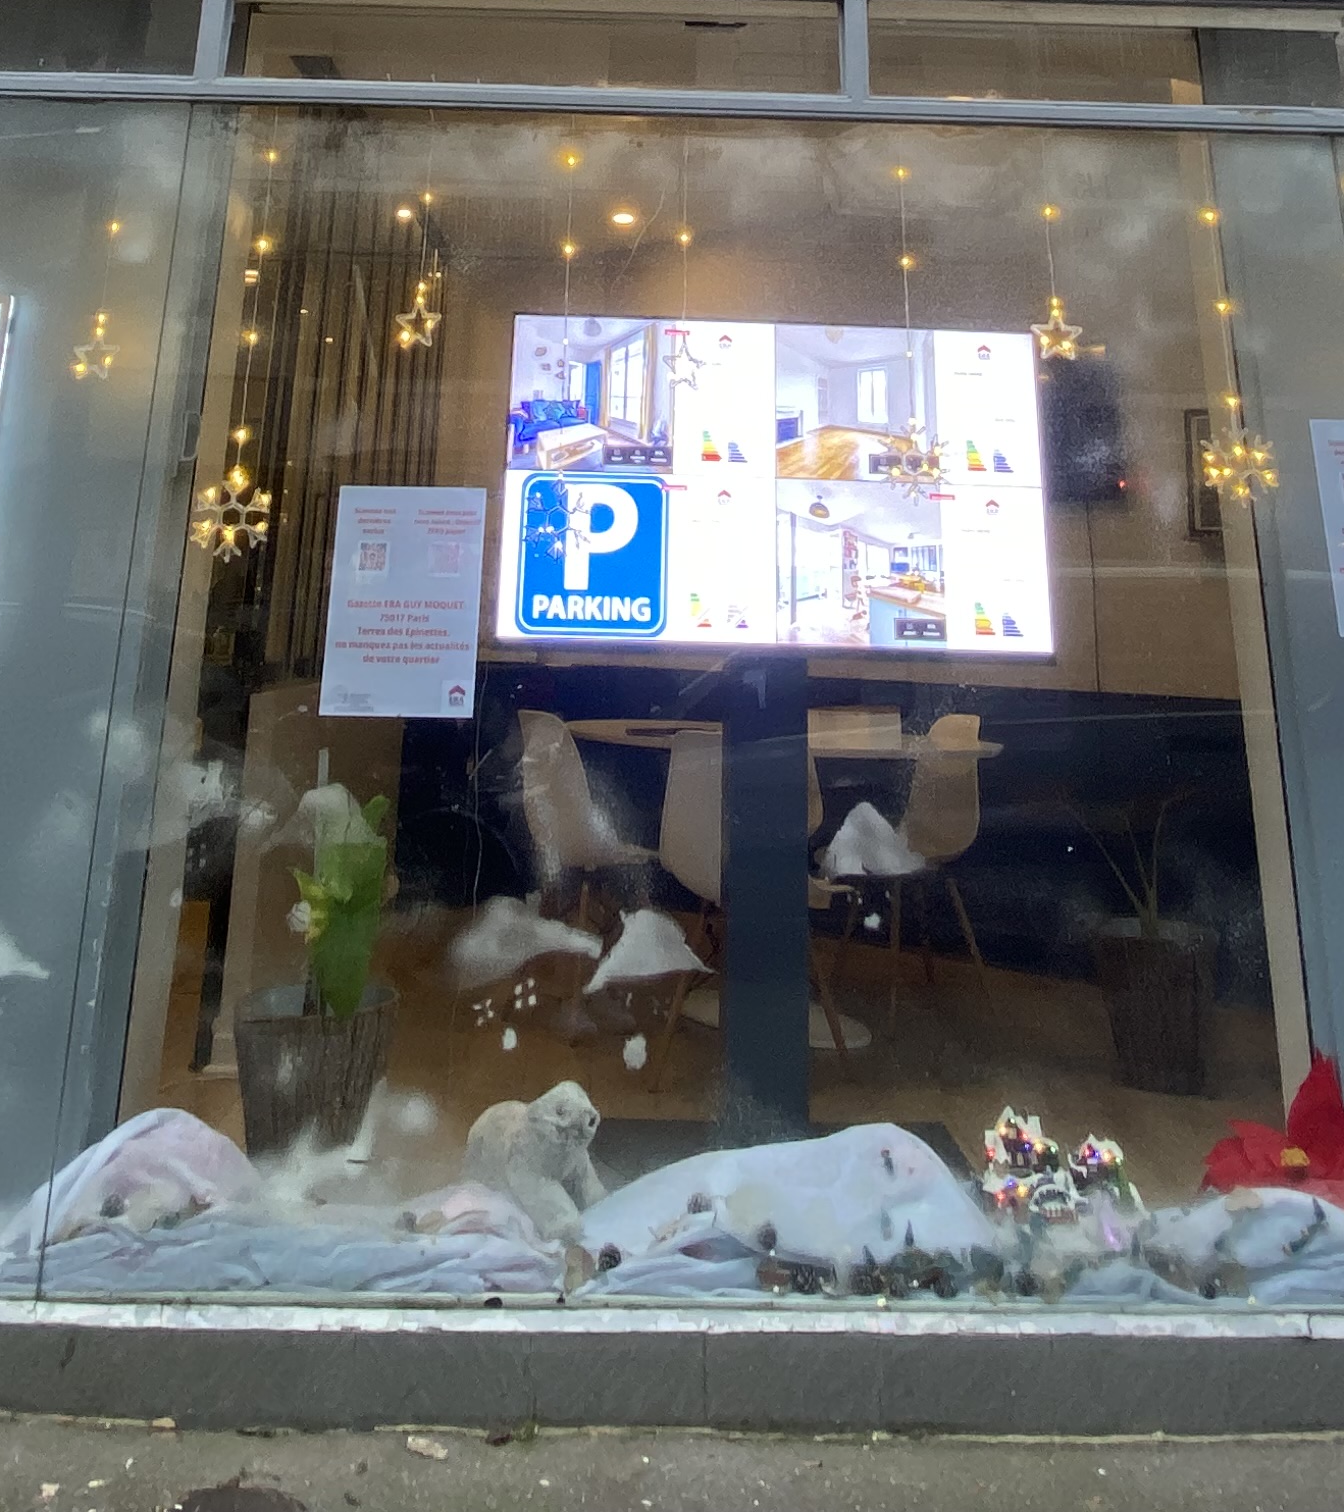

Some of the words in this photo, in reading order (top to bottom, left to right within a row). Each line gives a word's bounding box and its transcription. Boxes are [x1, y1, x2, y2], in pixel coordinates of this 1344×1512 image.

[563, 483, 639, 591] P
[403, 600, 423, 609] GUY
[425, 600, 465, 610] MOQUET
[531, 594, 652, 623] PARKING
[379, 613, 405, 622] 75017
[407, 614, 430, 623] Paris
